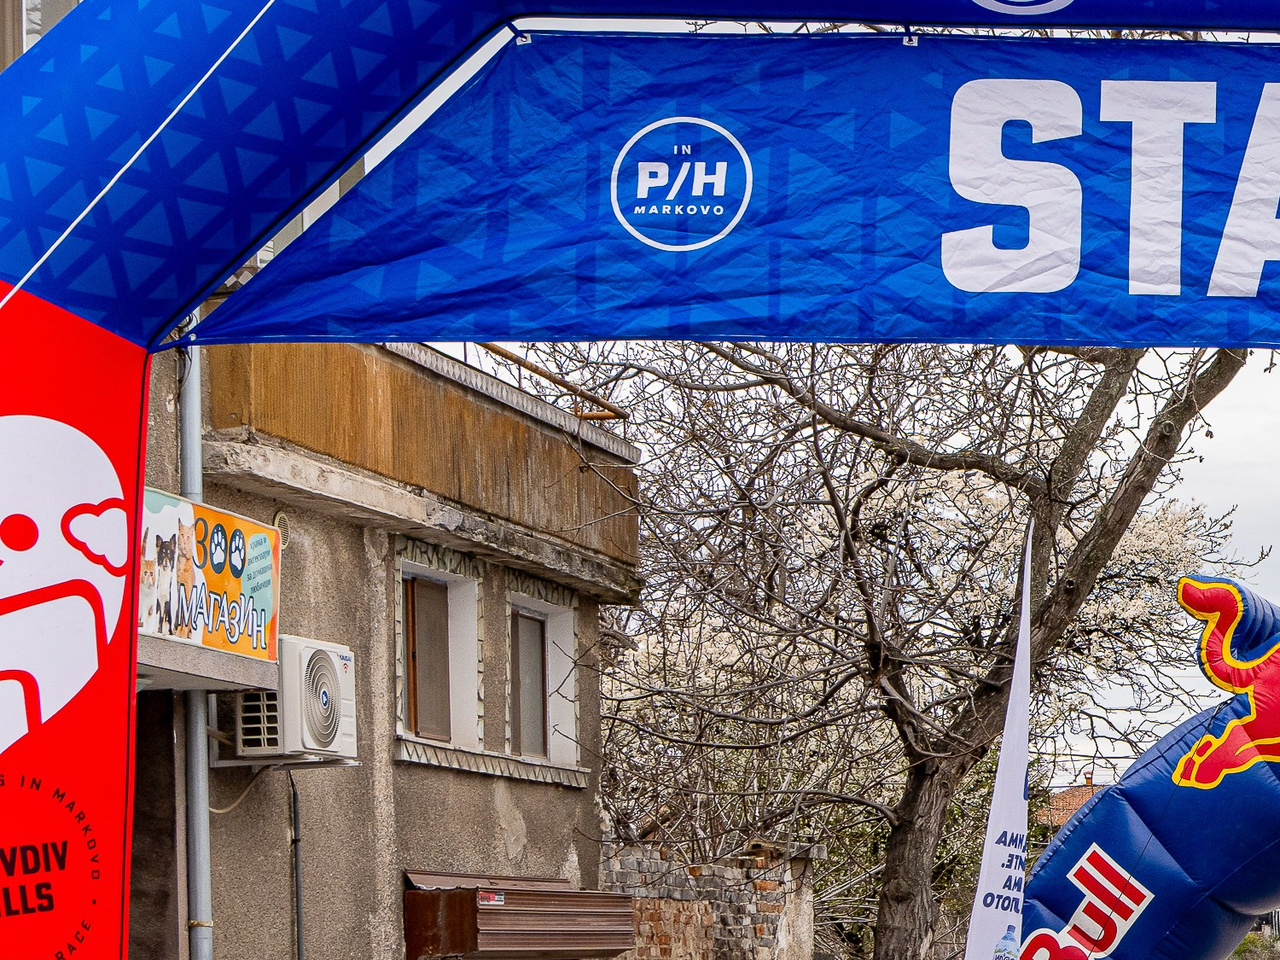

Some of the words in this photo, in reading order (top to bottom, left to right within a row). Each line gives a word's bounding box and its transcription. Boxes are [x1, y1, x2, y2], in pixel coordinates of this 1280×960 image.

[674, 145, 691, 155] IN
[637, 161, 727, 200] P/H
[634, 205, 724, 215] MARKOVO
[178, 582, 267, 650] МАГАЗИН
[20, 775, 42, 792] IN
[52, 787, 100, 880] MARKOVO
[0, 882, 55, 917] LLS
